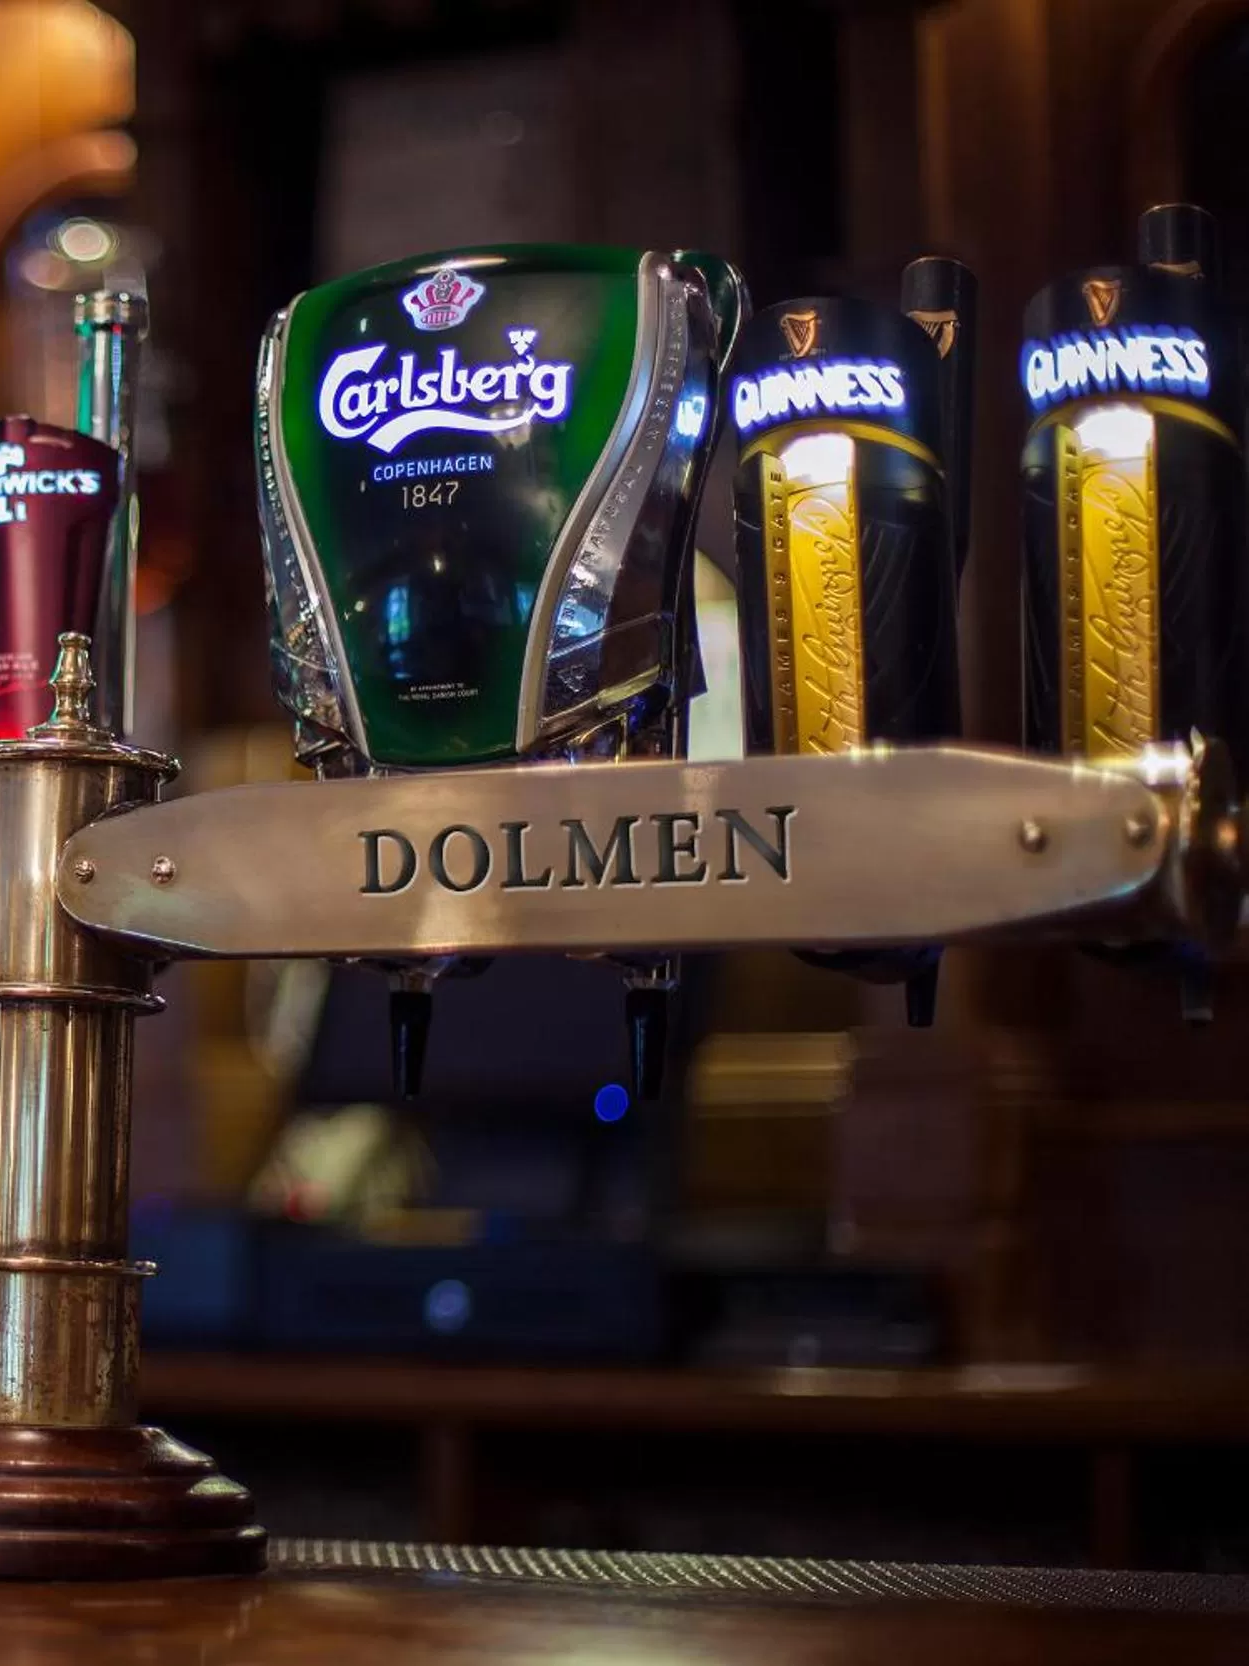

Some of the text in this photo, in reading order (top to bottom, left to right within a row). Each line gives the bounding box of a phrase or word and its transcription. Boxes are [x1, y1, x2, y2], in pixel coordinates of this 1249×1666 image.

[317, 331, 573, 452] Carlsberg
[373, 455, 493, 481] COPENHAGEN
[402, 481, 460, 509] 1847
[358, 806, 797, 894] DOLMEN
